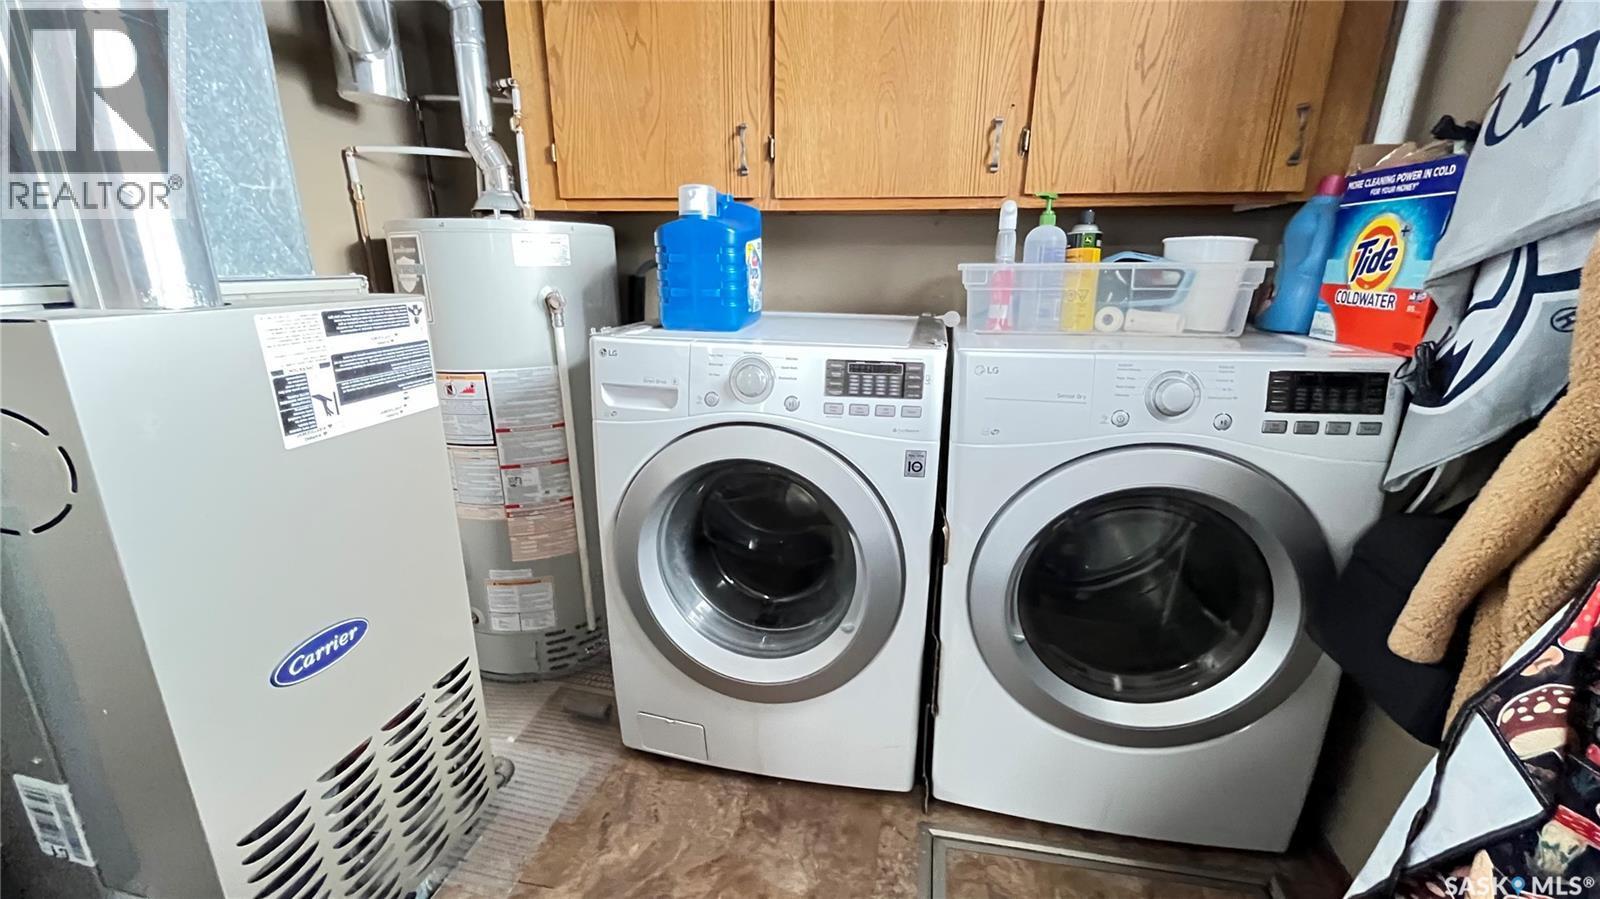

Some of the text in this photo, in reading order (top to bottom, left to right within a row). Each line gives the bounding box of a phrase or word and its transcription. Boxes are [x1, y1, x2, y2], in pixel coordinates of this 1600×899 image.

[1347, 164, 1457, 190] MORE CLEANING POWER IN COLD
[1369, 187, 1381, 196] FOR
[1381, 185, 1397, 195] YOUR
[1350, 234, 1398, 283] Tide
[1335, 290, 1397, 310] COLDWATER
[608, 349, 618, 358] LG
[986, 366, 999, 375] LG
[288, 626, 358, 676] Carrier
